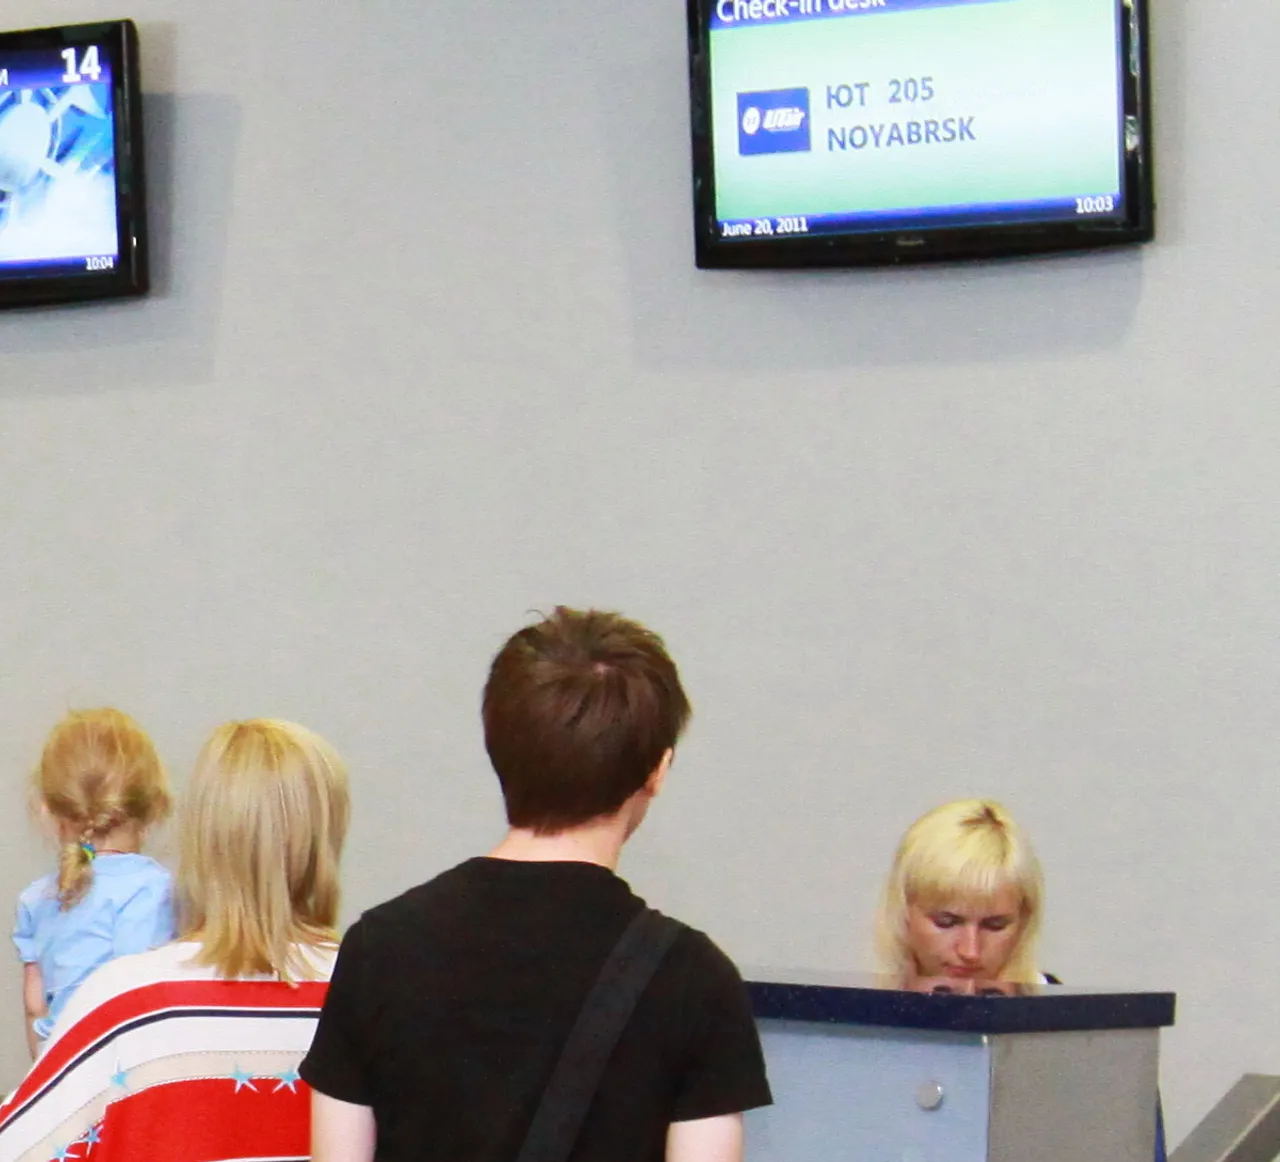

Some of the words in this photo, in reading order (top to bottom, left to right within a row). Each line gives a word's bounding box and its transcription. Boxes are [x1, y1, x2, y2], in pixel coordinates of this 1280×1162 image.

[716, 0, 823, 22] Check-in
[828, 0, 886, 11] es
[61, 45, 102, 83] 14
[888, 76, 934, 104] 205
[827, 116, 976, 152] NOYABRSK
[1075, 196, 1115, 214] 10:03
[721, 222, 752, 237] June
[754, 219, 774, 236] 20,
[776, 216, 809, 234] 2011
[85, 256, 113, 270] 10:04
